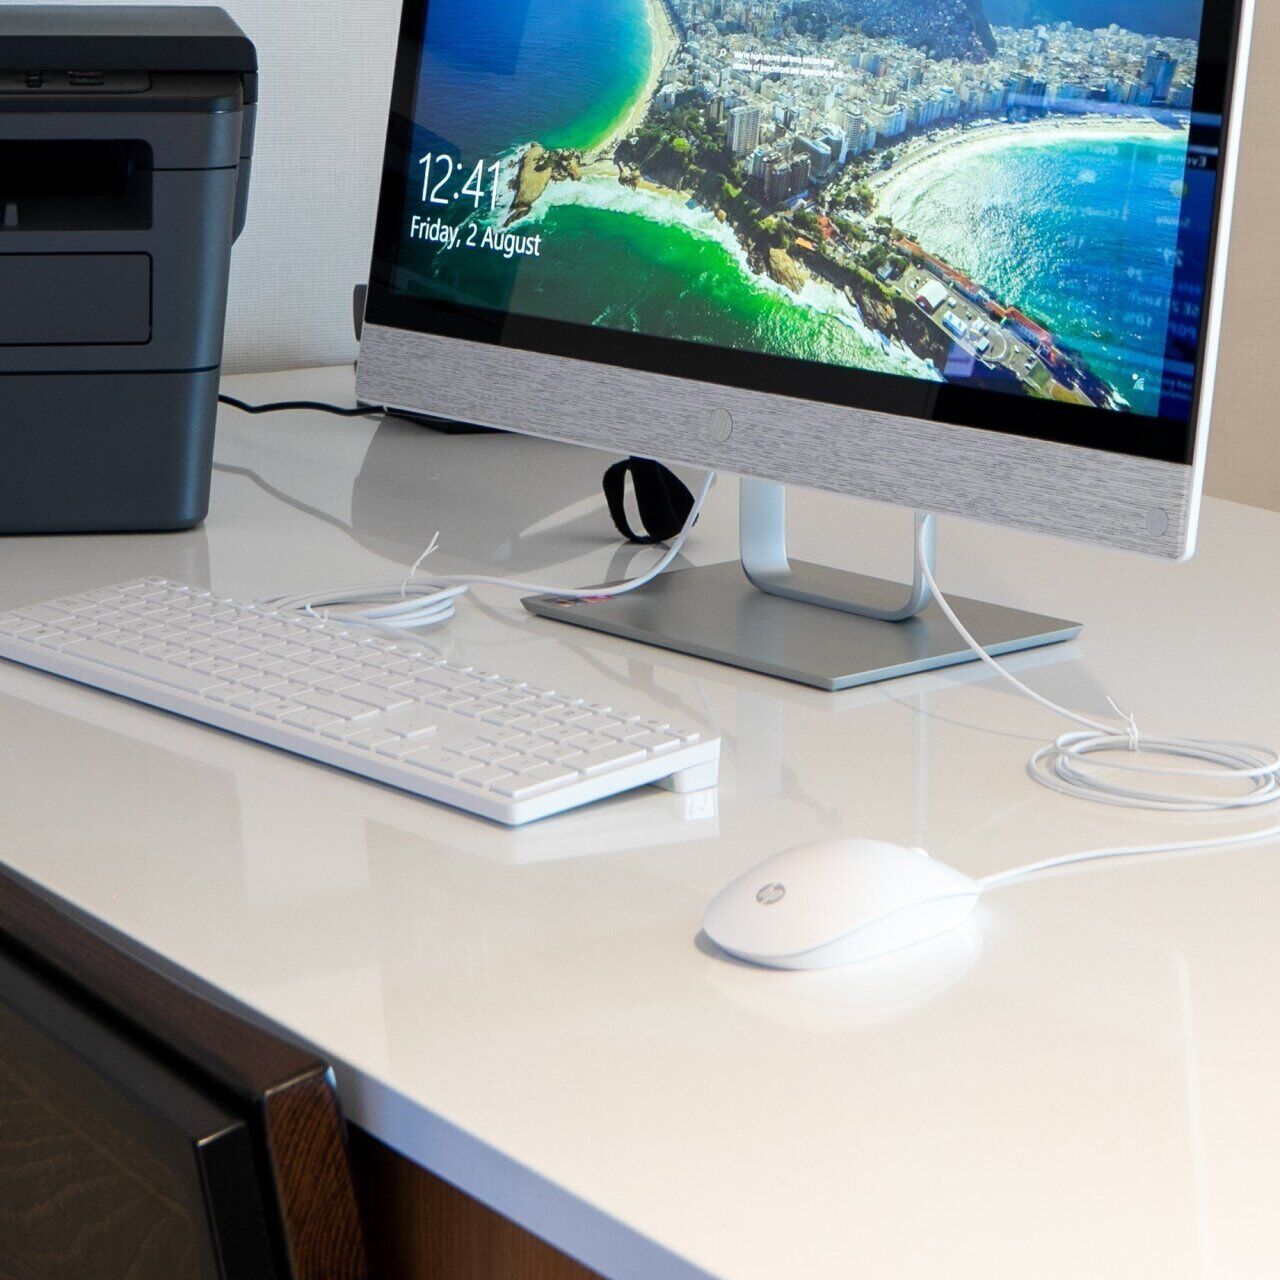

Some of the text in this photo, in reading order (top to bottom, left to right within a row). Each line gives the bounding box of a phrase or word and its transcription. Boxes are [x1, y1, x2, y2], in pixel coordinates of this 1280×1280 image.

[418, 151, 502, 211] 12:41
[410, 215, 542, 259] Friday, 2 August
